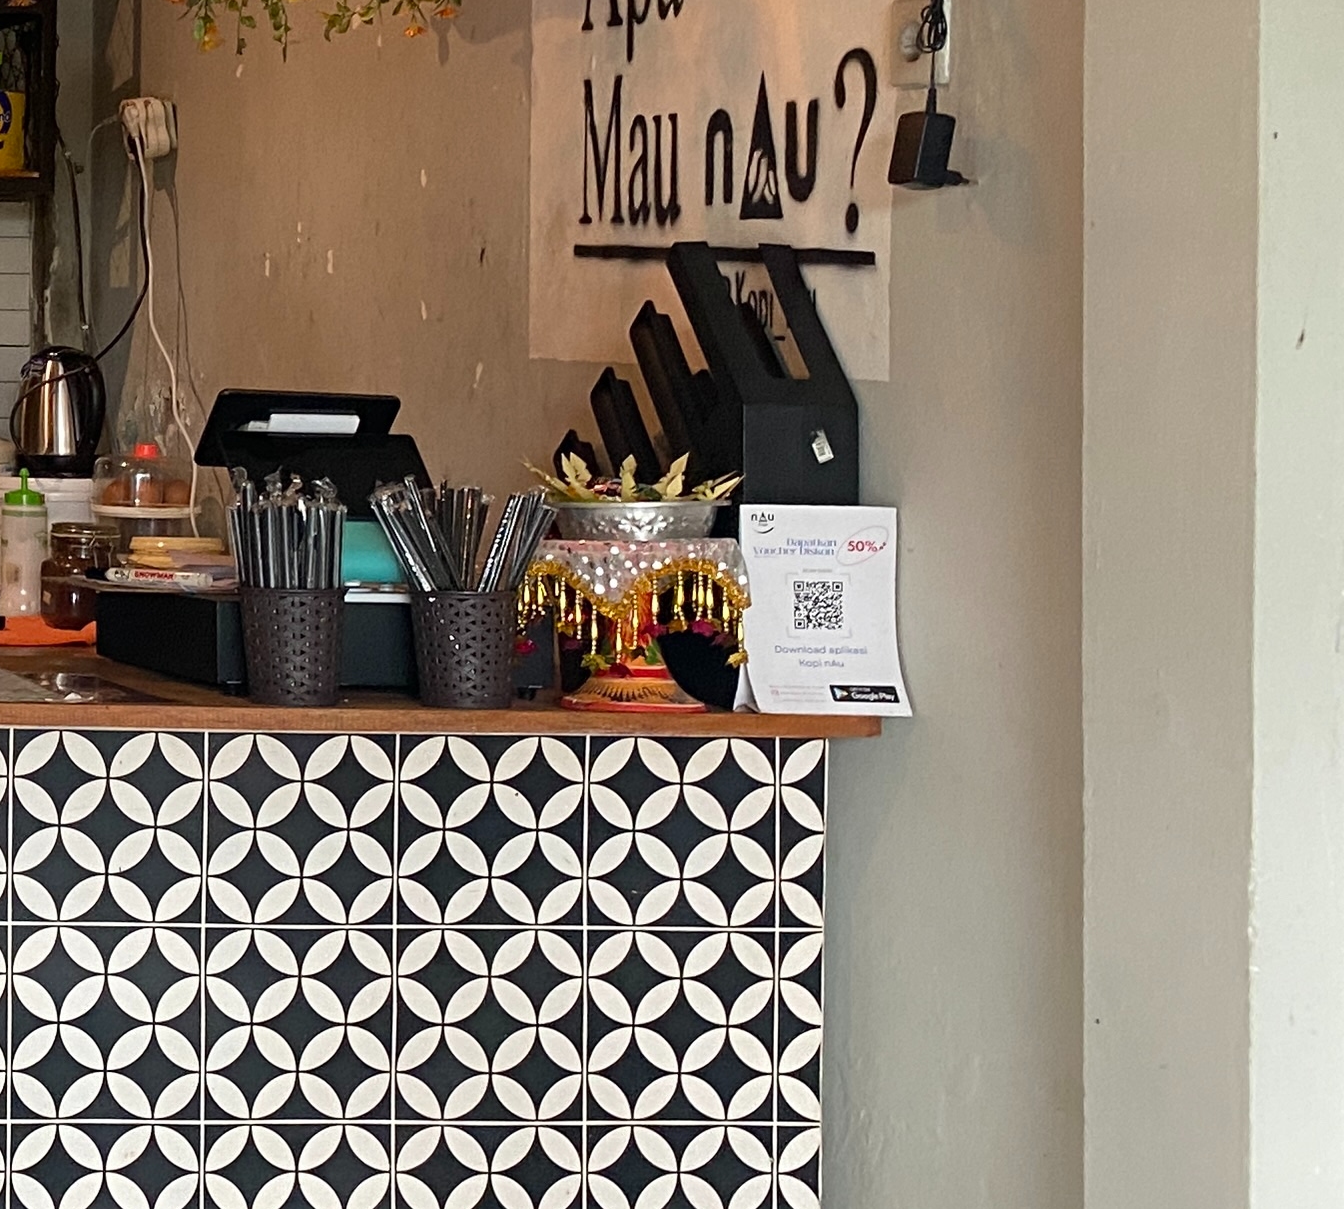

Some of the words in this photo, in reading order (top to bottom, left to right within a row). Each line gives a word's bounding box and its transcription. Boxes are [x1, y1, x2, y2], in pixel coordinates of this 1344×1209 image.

[579, 74, 681, 228] Mau
[847, 540, 879, 553] 50%
[774, 645, 826, 654] Download
[829, 645, 868, 656] aplikasi
[799, 659, 822, 668] Kopi
